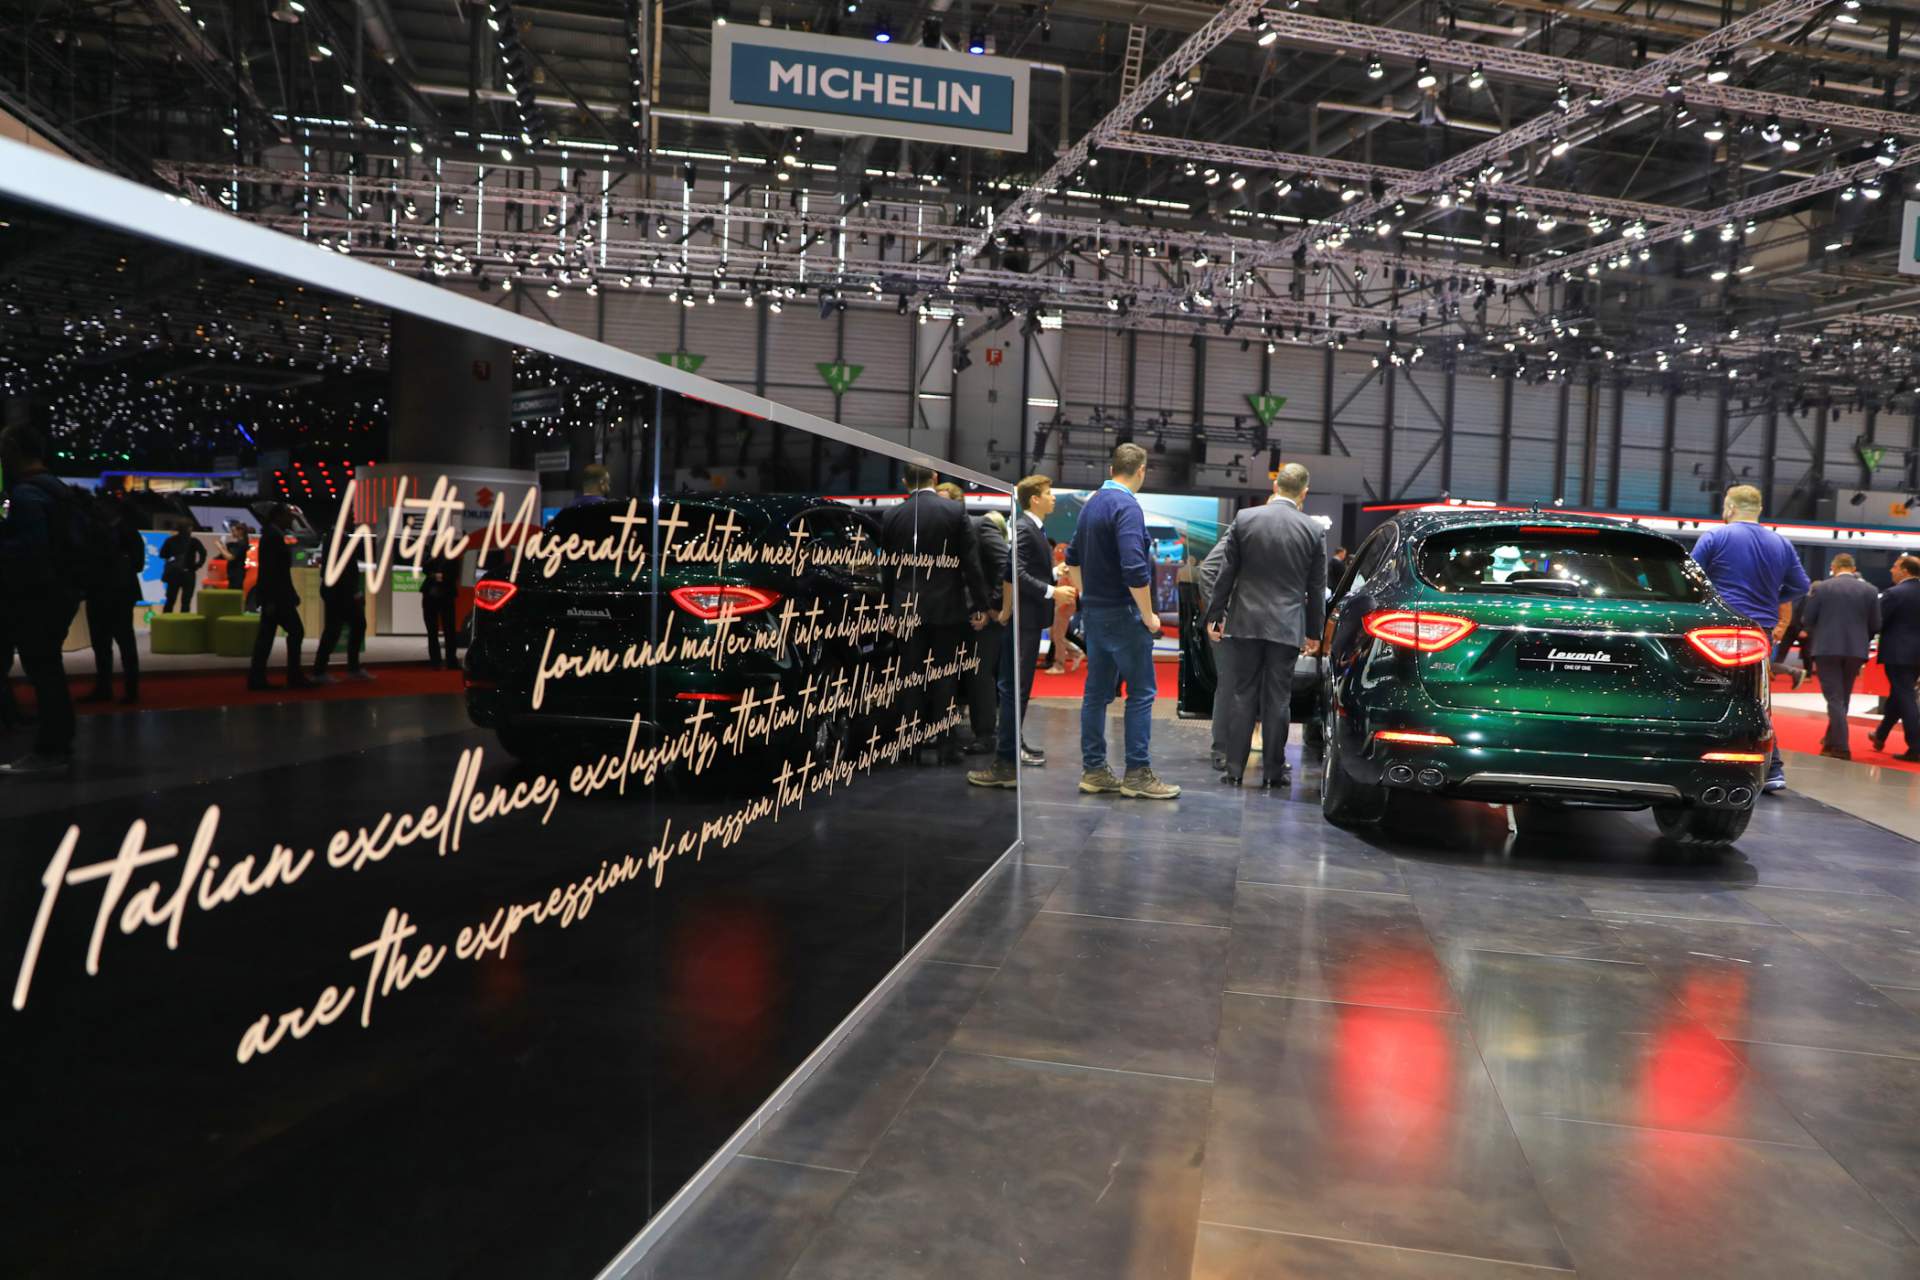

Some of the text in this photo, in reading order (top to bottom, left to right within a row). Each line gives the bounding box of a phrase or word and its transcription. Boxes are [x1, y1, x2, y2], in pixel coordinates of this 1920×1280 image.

[769, 60, 981, 115] MICHELIN
[325, 475, 470, 594] With
[478, 486, 647, 583] Maserati,
[761, 518, 809, 577] meets
[811, 524, 875, 576] innovation
[876, 547, 889, 567] in
[890, 549, 899, 565] a
[897, 548, 935, 581] journey
[935, 538, 960, 568] where
[532, 628, 618, 711] form
[622, 610, 677, 669] and
[680, 601, 751, 671] matter
[754, 598, 800, 661] melt
[794, 596, 824, 655] into
[824, 621, 837, 639] a
[837, 592, 898, 647] distinctive
[1547, 648, 1612, 662] Levante
[13, 804, 314, 1010] Italian
[326, 747, 561, 856] excellence,
[569, 697, 718, 795] exclusivity,
[722, 681, 800, 756] attention
[798, 673, 818, 734] to
[858, 656, 904, 716] lifestyle
[903, 671, 924, 689] over
[922, 647, 943, 692] time
[942, 645, 959, 675] and
[235, 984, 356, 1064] are
[349, 906, 449, 1028] the
[454, 845, 644, 959] expression
[646, 818, 676, 888] of
[677, 831, 698, 856] a
[696, 797, 774, 862] passion
[771, 750, 816, 823] that
[811, 739, 856, 796] evolves
[857, 724, 881, 776] into
[880, 709, 923, 764] aesthetic
